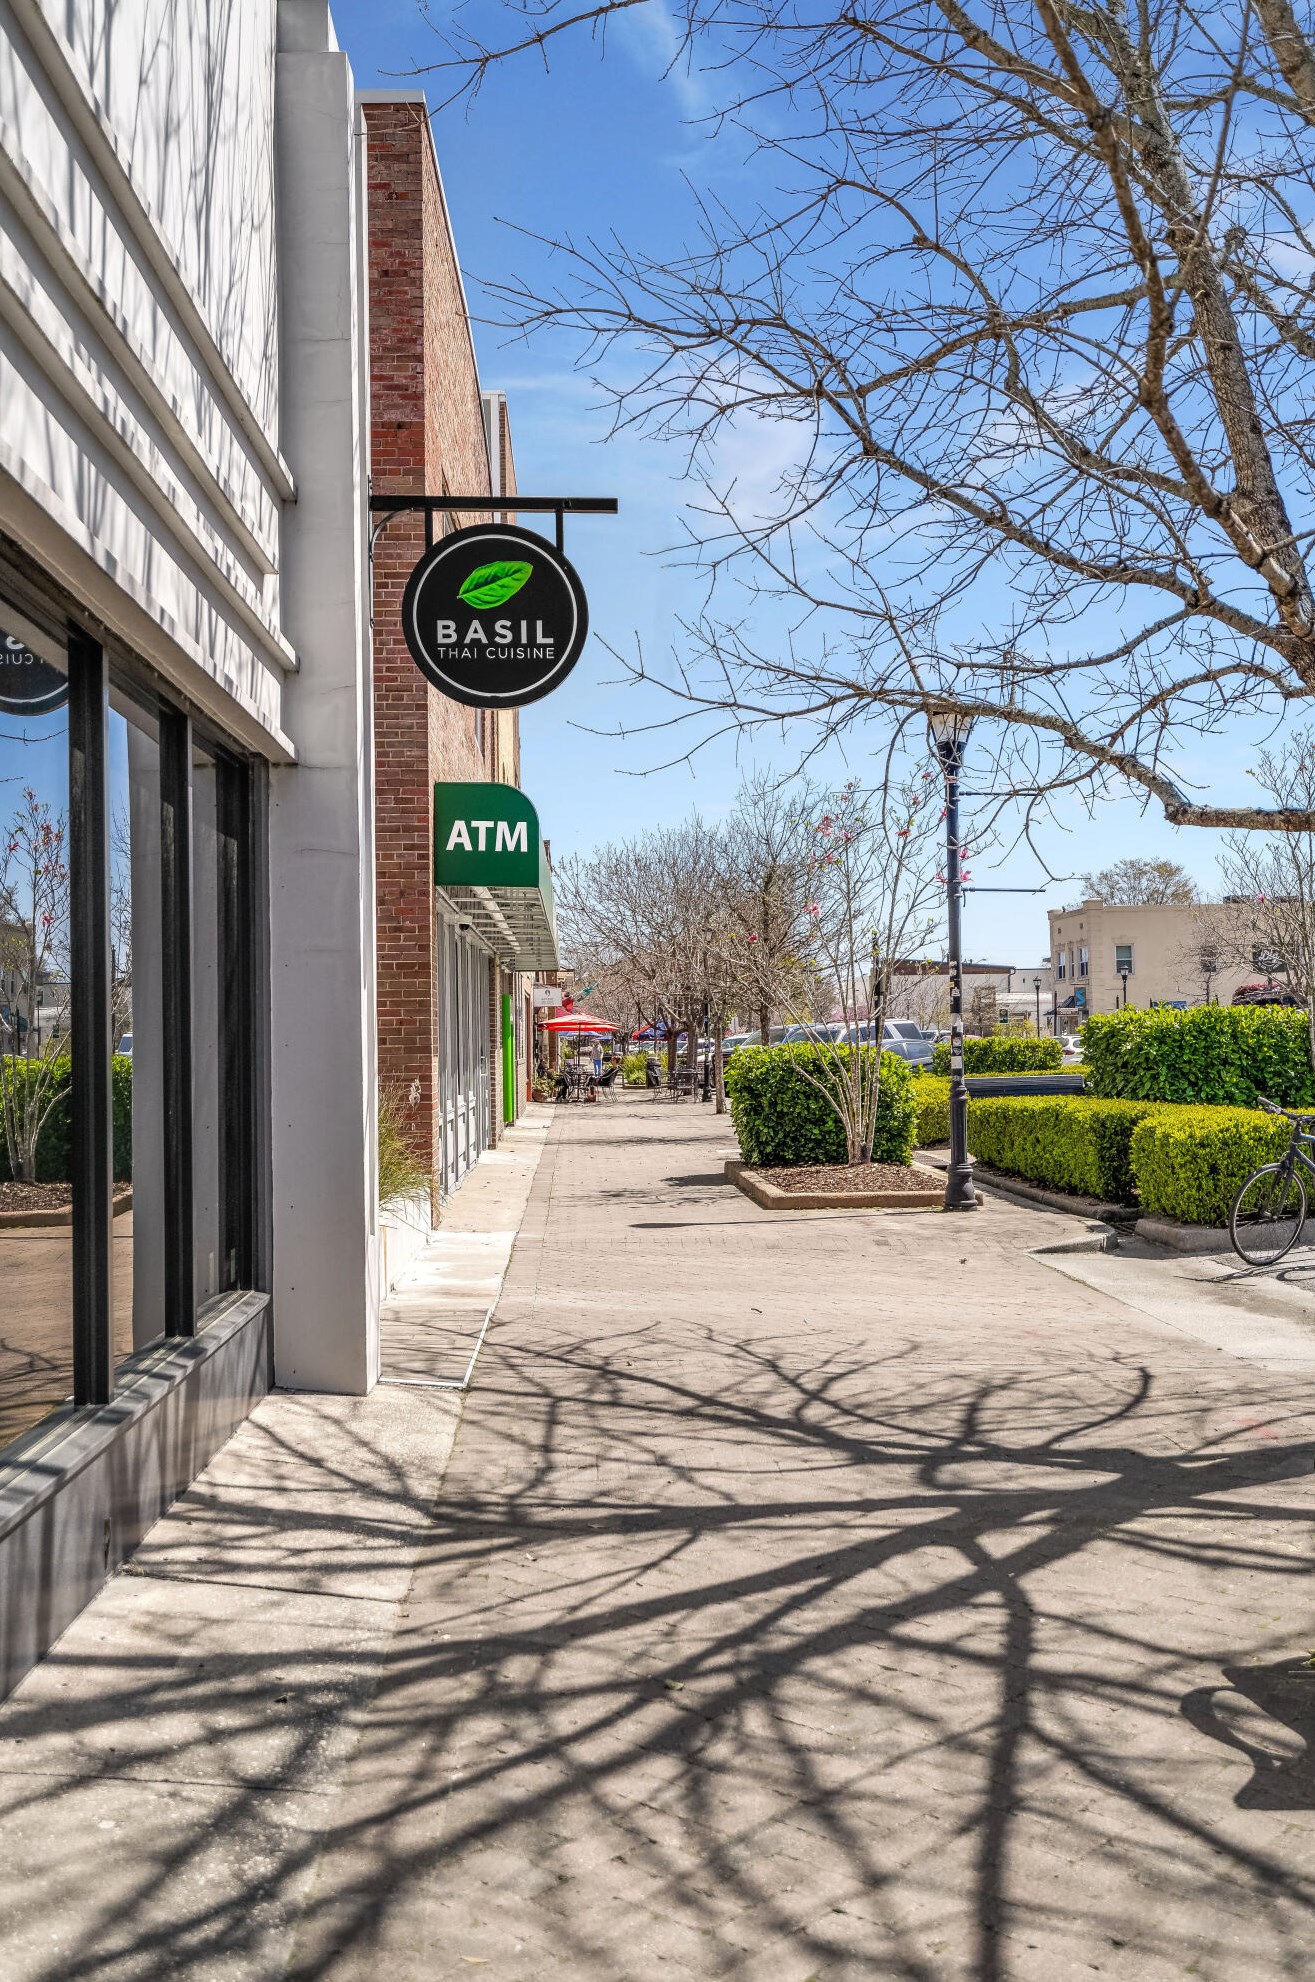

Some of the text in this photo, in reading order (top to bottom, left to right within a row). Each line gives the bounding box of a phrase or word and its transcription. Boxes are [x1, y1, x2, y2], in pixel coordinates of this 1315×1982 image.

[437, 619, 554, 644] BASIL
[437, 647, 555, 659] THAI CUISINE
[446, 820, 528, 852] ATM
